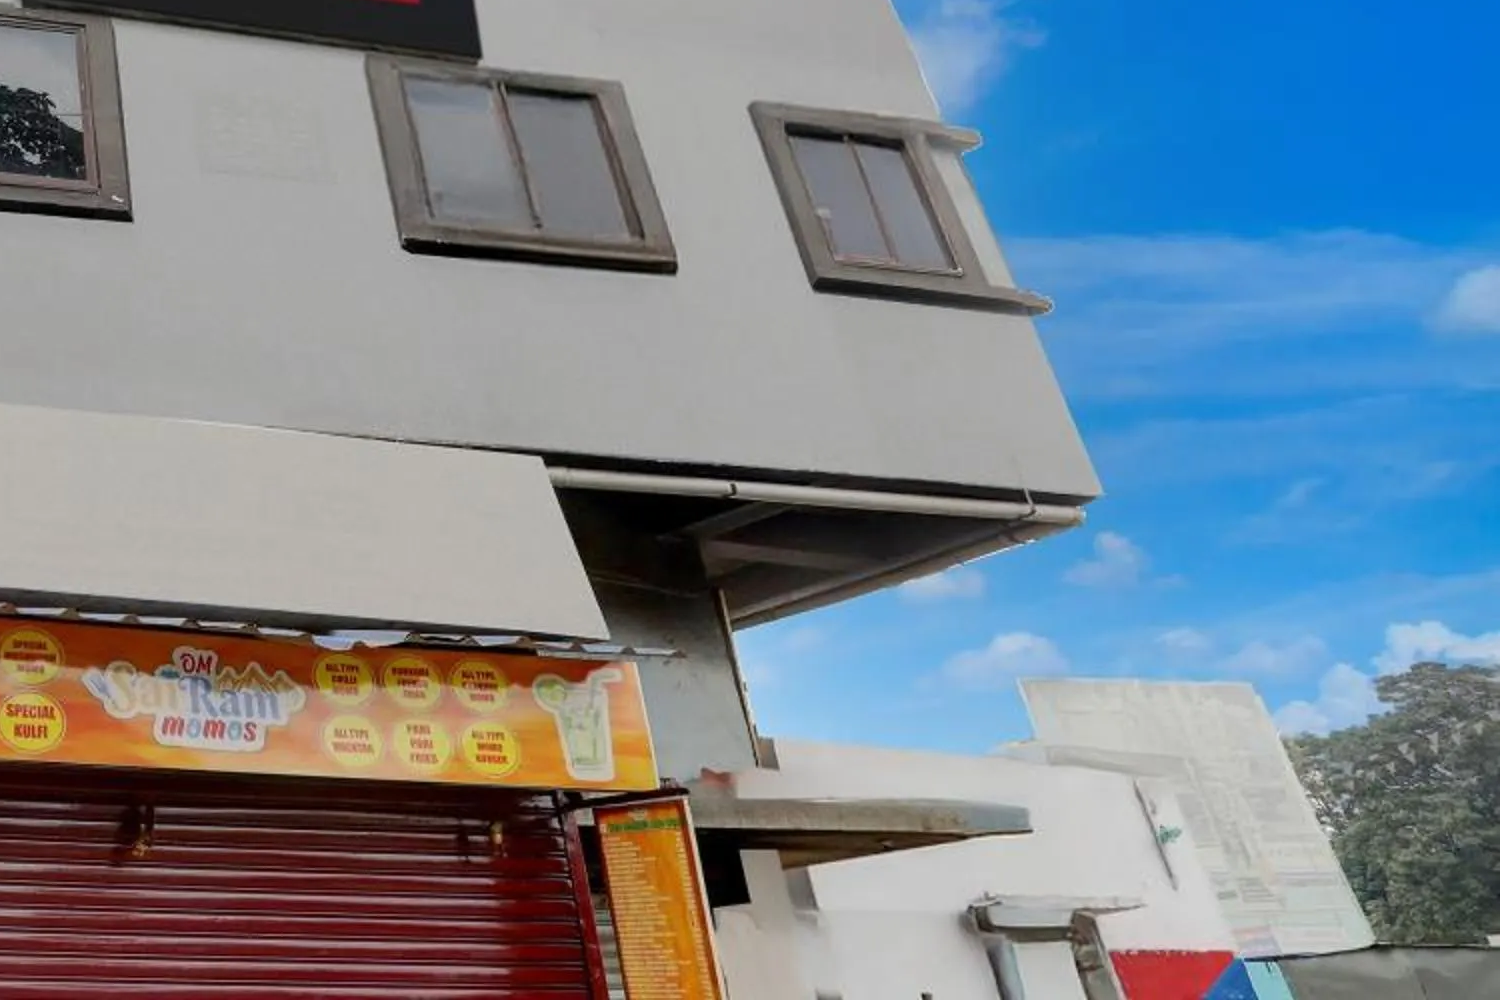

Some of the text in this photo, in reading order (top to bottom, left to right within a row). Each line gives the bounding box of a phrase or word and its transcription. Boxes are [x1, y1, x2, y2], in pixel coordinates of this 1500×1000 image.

[180, 653, 212, 674] OM
[4, 703, 56, 720] SPECIAL
[13, 723, 48, 738] KULFI
